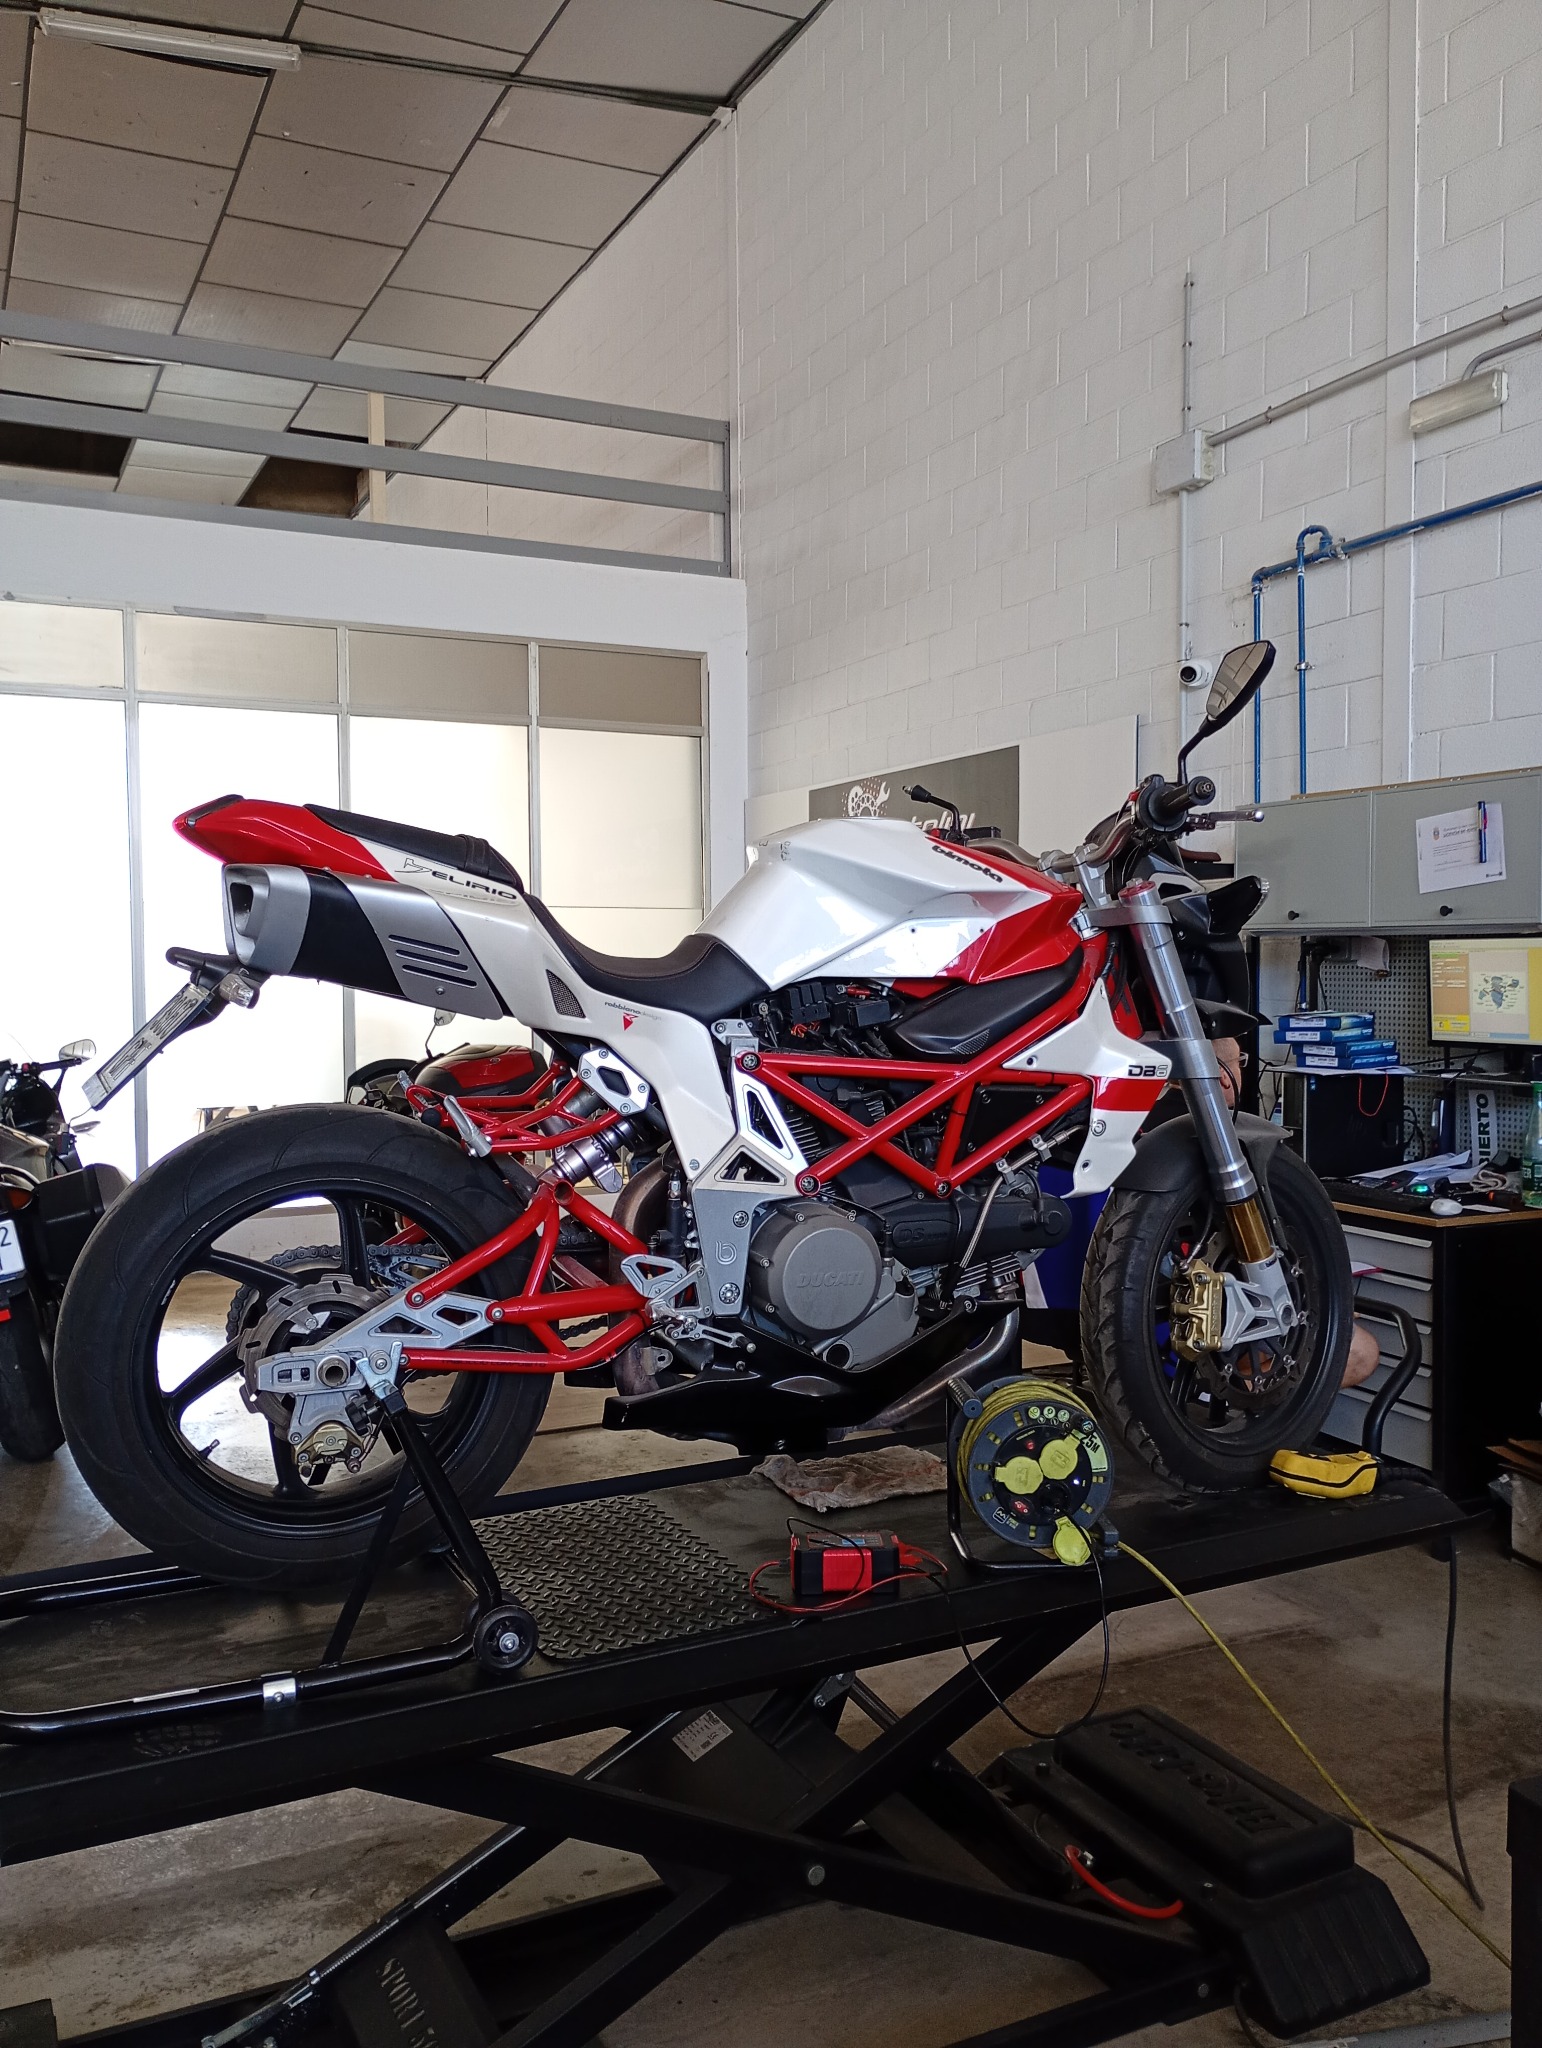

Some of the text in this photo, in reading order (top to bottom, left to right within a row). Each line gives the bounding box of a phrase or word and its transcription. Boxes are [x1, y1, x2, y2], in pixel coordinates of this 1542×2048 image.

[931, 845, 1003, 883] bimota
[1127, 1064, 1168, 1077] DB6
[796, 1270, 864, 1289] DUCATI
